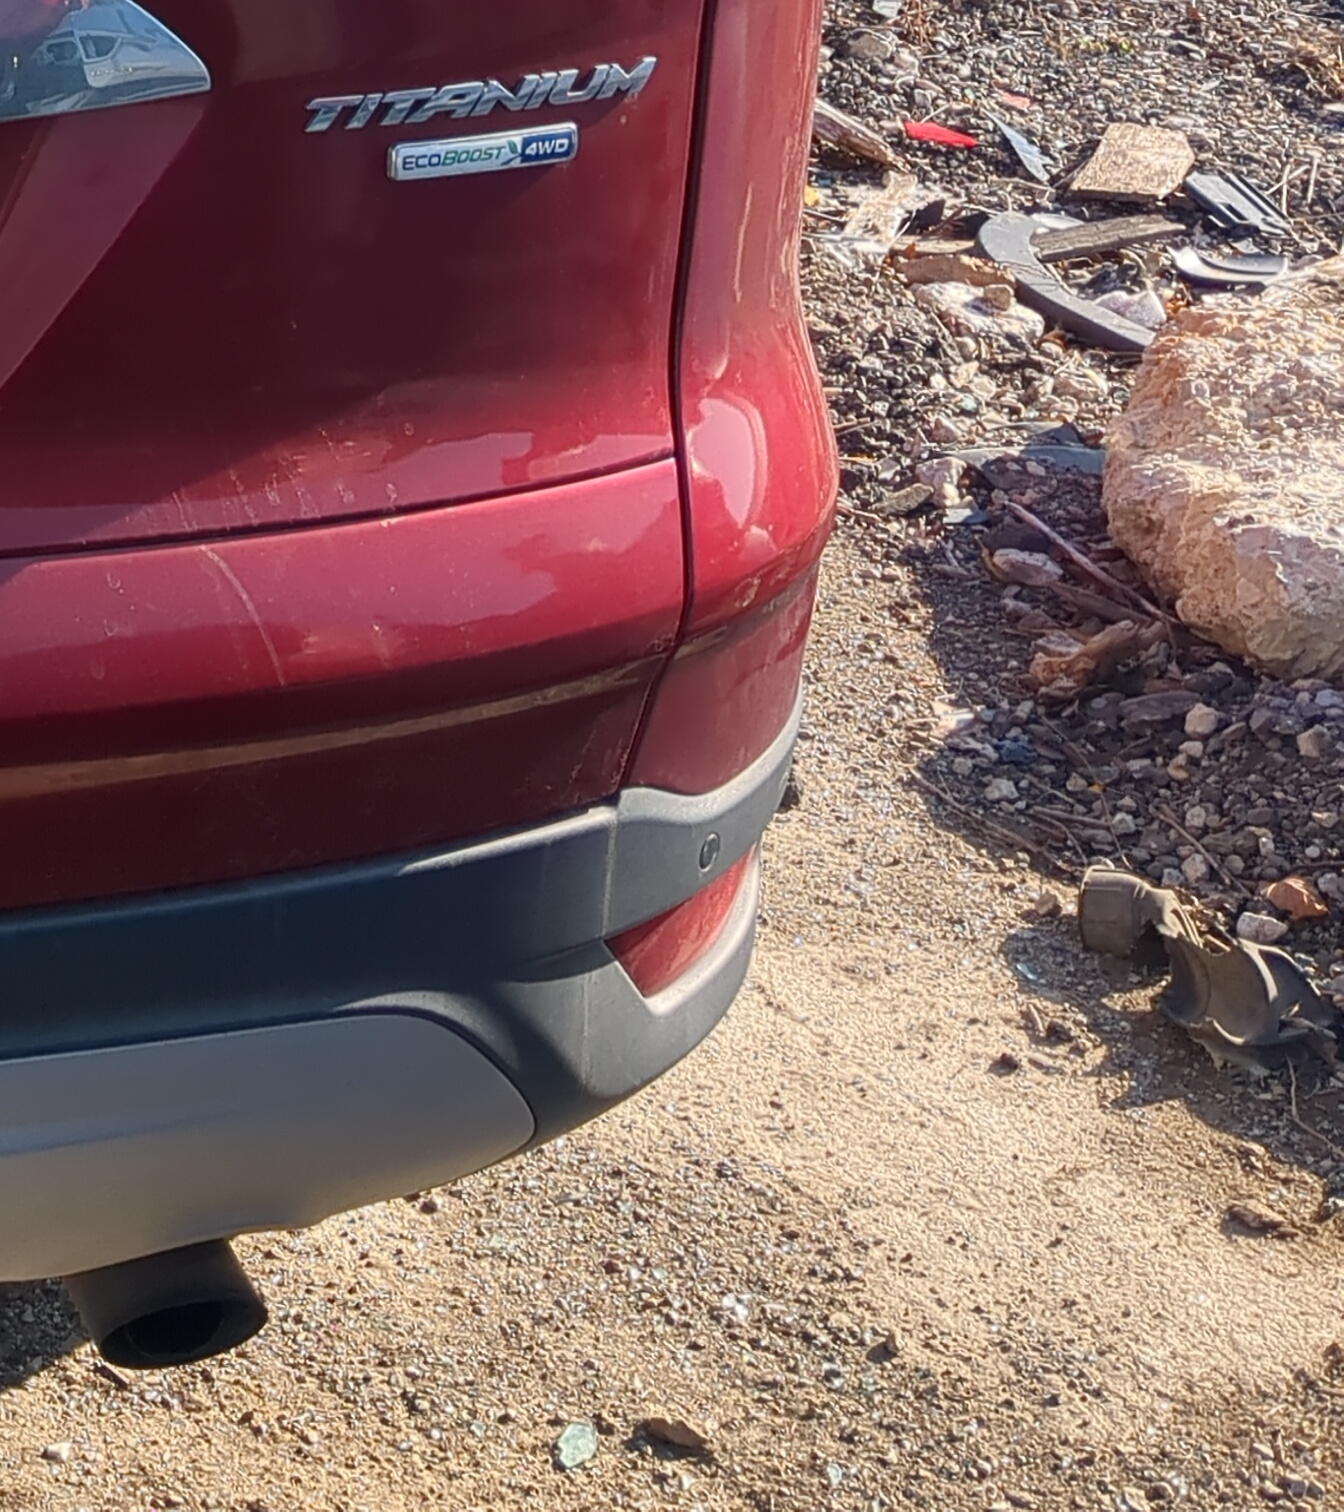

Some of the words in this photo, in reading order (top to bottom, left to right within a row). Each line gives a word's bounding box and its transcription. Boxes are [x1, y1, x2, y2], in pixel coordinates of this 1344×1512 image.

[303, 55, 658, 133] TITANIUM
[401, 144, 508, 171] ECOBOOST
[523, 137, 570, 157] 4WD
